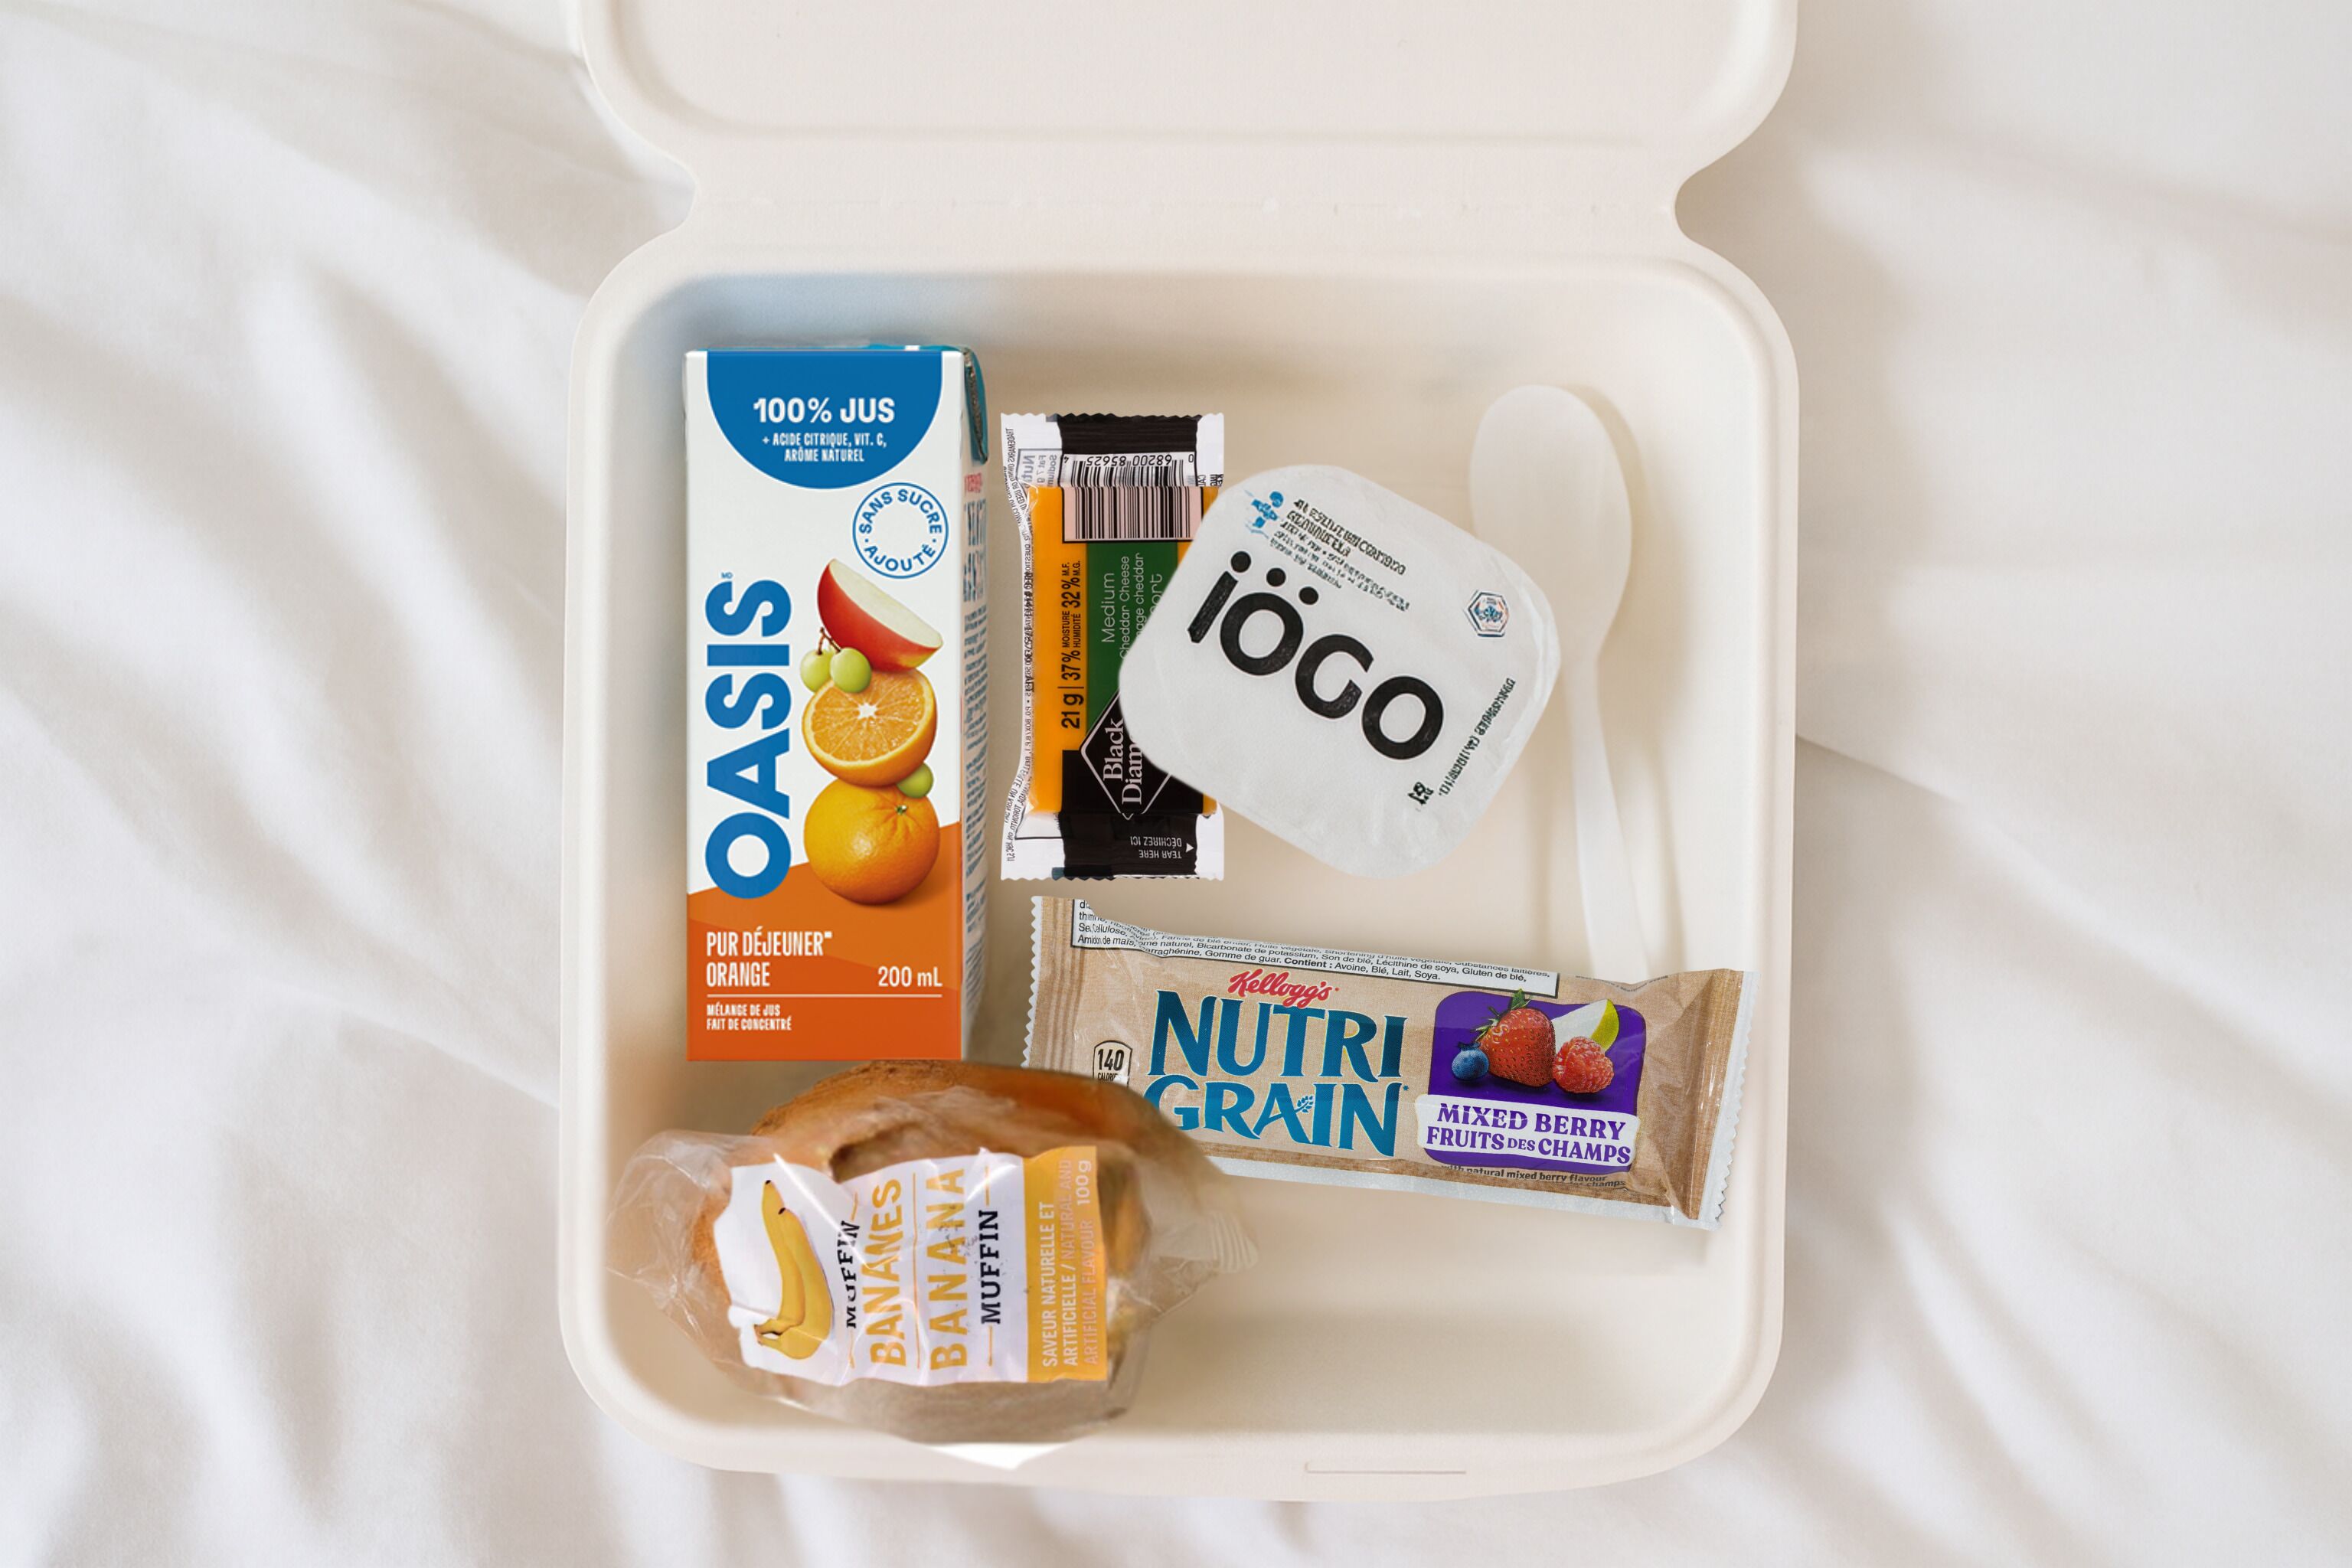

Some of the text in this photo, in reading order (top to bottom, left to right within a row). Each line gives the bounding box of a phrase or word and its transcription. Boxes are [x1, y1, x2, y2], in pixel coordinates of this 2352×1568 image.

[753, 397, 895, 423] 100% JUS
[773, 433, 801, 446] ACIDE
[804, 433, 851, 448] CITRIQUE,
[854, 433, 874, 446] VIT.
[877, 433, 887, 448] C,
[784, 446, 864, 462] ARÔME NATUREL
[1086, 455, 1126, 466] 85625
[1132, 454, 1172, 466] 68200
[1188, 454, 1194, 462] 0
[859, 489, 942, 572] SANS SUCRE AJOUTÉ
[1133, 553, 1144, 605] cheddar
[1100, 573, 1115, 642] Medium
[1119, 556, 1130, 658] Cheddar Cheese
[1071, 613, 1080, 648] HUMIDITÉ
[1061, 650, 1084, 729] 21 g 37%
[705, 580, 792, 899] OASIS
[1102, 717, 1124, 782] Black
[1122, 743, 1142, 805] Diam
[1130, 836, 1182, 849] DÉCHIREZ ICI
[1138, 849, 1182, 859] TEAR HERE
[707, 926, 824, 956] PUR DÉJEUNER
[1102, 936, 1111, 944] de
[1112, 938, 1136, 947] maïs,
[1205, 950, 1242, 959] Gomme
[1284, 957, 1327, 969] Contient
[1334, 962, 1368, 973] Avoine,
[1371, 965, 1389, 975] Blé,
[1392, 968, 1412, 978] Lait,
[1414, 970, 1440, 981] Soya.
[707, 962, 770, 987] ORANGE
[878, 966, 942, 987] 200 mL
[1197, 942, 1252, 952] Bicarbonate
[1269, 949, 1318, 959] potassium,
[1377, 959, 1418, 969] Lécithine
[1435, 965, 1459, 974] soya,
[1462, 967, 1492, 977] Gluten
[1510, 974, 1527, 982] blé,
[1228, 968, 1334, 1008] Kellogg's
[707, 1001, 780, 1016] MÉLANGE DE JUS
[707, 1016, 792, 1031] FAIT DE CONCENTRÉ
[1148, 989, 1408, 1083] NUTRI
[1097, 1048, 1125, 1071] 140
[1143, 1074, 1403, 1157] GRAIN
[1436, 1102, 1626, 1141] MIXED BERRY
[1426, 1125, 1631, 1165] FRUITS DES CHAMPS
[1059, 1160, 1072, 1191] AND
[1466, 1168, 1504, 1177] natural
[1506, 1171, 1537, 1180] mixed
[1539, 1172, 1566, 1182] berry
[1570, 1174, 1607, 1183] flavour
[1059, 1194, 1075, 1259] NATURAL
[926, 1169, 967, 1370] BANANA
[978, 1210, 1001, 1325] MUFFIN
[1080, 1219, 1097, 1284] FLAVOUR
[838, 1220, 860, 1328] MUFFIN
[861, 1179, 906, 1367] BANANES
[1039, 1201, 1057, 1367] SAVEUR NATURELLE ET
[1061, 1274, 1078, 1366] ARTIFICIELLE
[1083, 1287, 1098, 1364] ARTIFICIAL
